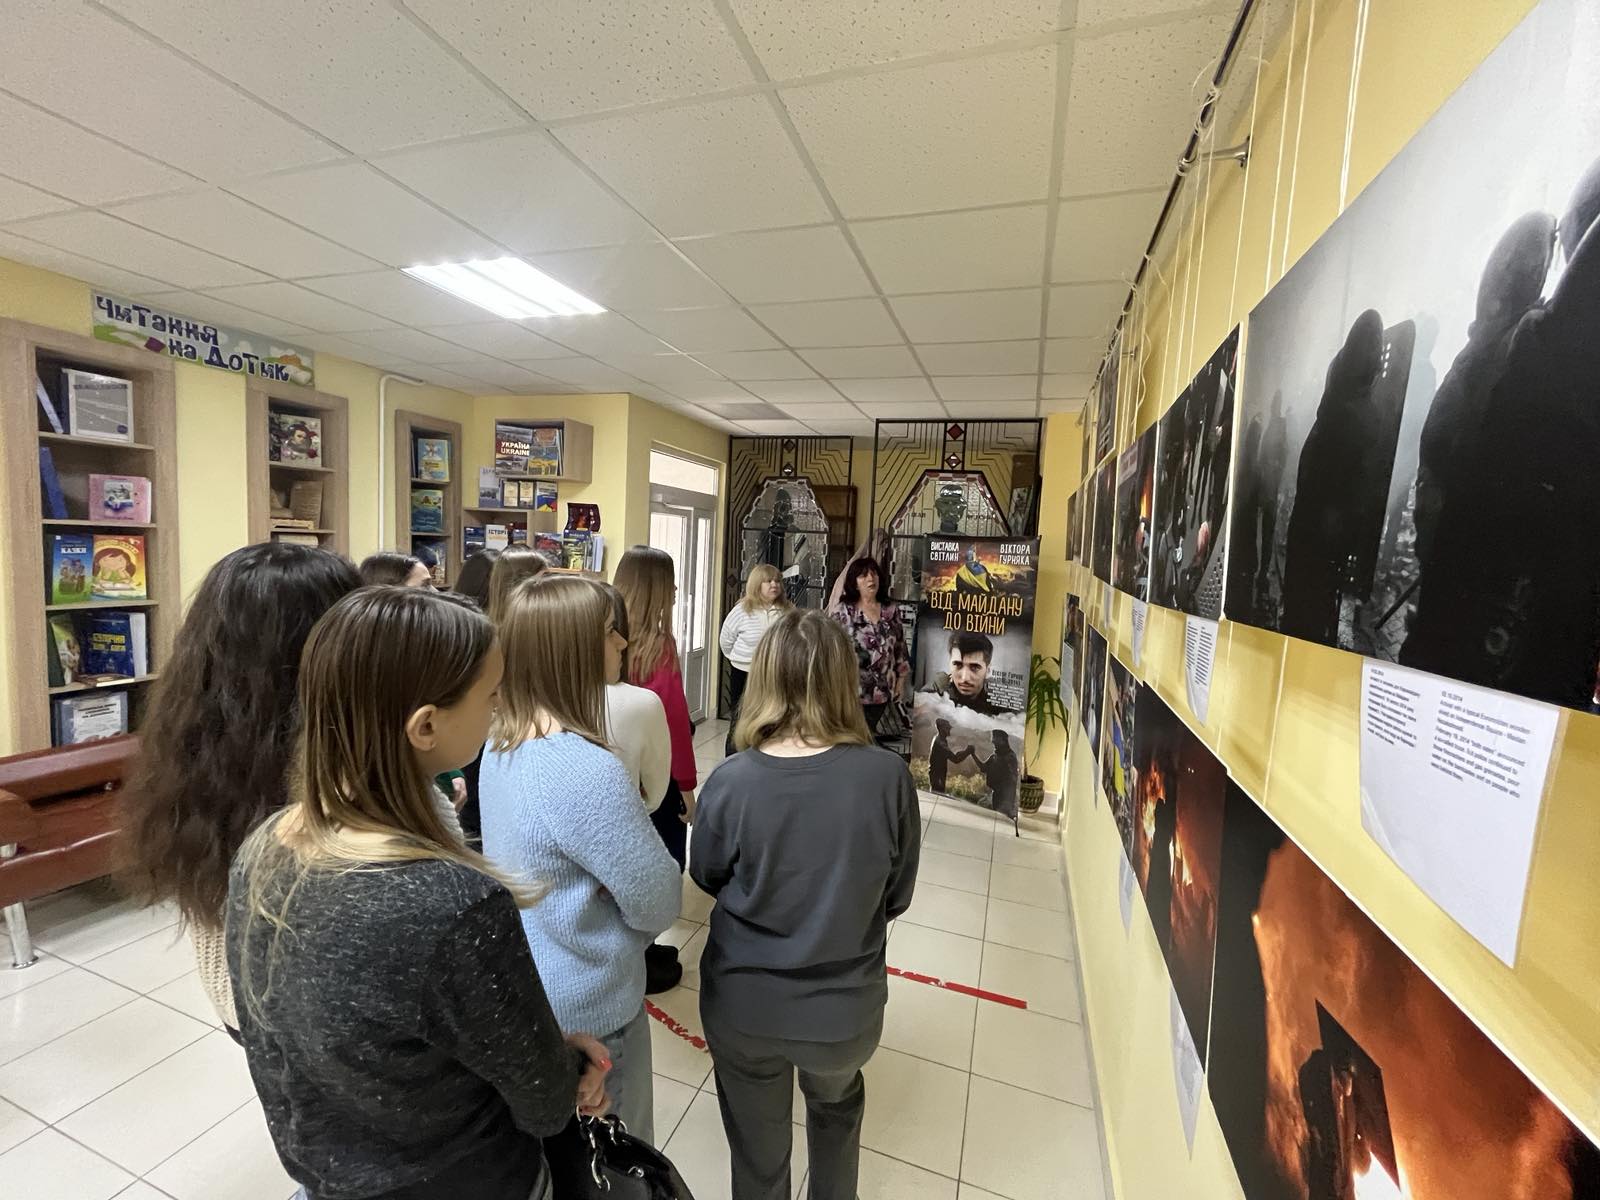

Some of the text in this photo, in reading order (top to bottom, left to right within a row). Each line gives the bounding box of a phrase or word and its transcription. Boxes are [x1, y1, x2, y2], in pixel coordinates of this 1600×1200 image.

[168, 338, 198, 360] на
[501, 441, 531, 450] УКРАЇНА
[501, 447, 530, 456] UKRAINE
[930, 541, 1031, 555] ВИСТАВКА ВІКТОРА
[930, 551, 1030, 566] СВІТЛИН ГУРНЯКА
[930, 591, 1023, 617] ВІД МАЙДАНУ
[943, 612, 1006, 635] ДО ВІЙНИ
